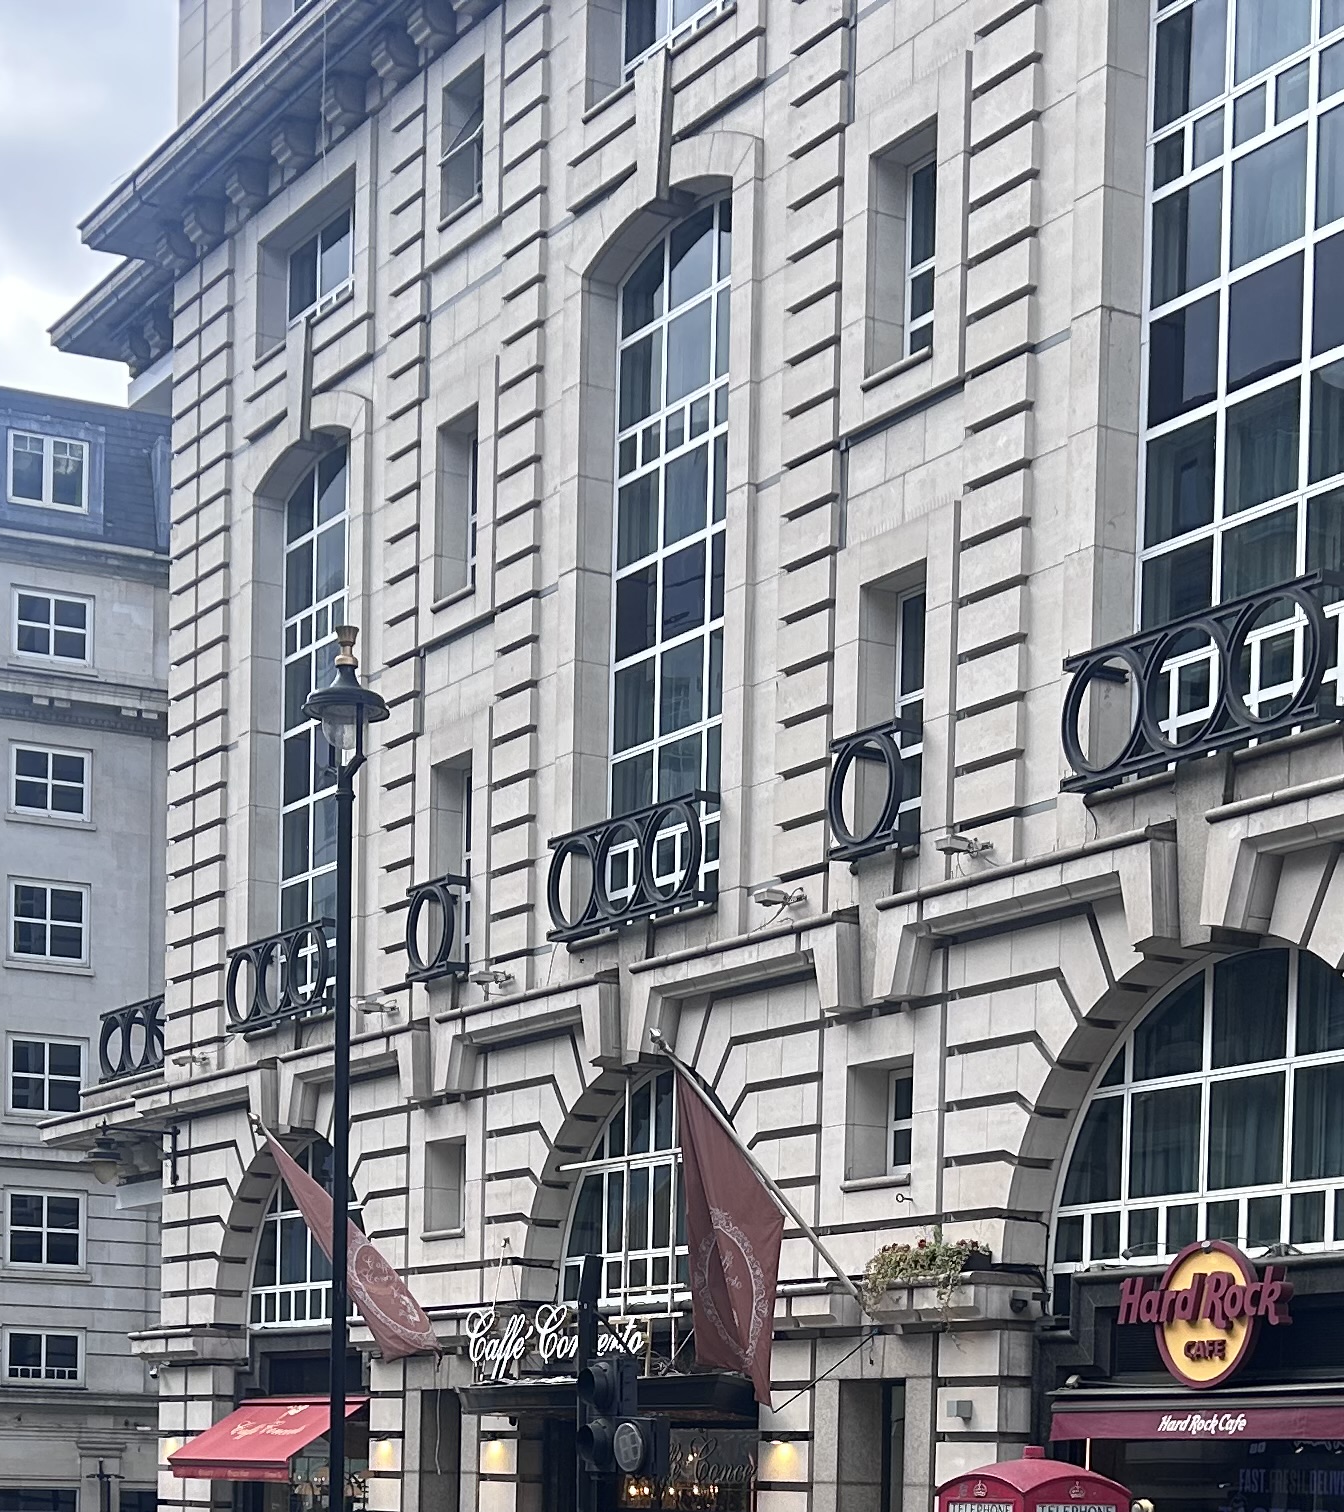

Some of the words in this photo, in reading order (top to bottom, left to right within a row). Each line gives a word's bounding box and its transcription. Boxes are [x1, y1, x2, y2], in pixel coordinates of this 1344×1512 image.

[1117, 1272, 1207, 1325] Hard
[1202, 1265, 1290, 1330] Rock
[1184, 1339, 1227, 1361] CAFE
[1157, 1414, 1192, 1431] Hard
[1188, 1413, 1219, 1435] Rock
[1218, 1413, 1247, 1435] Cafe
